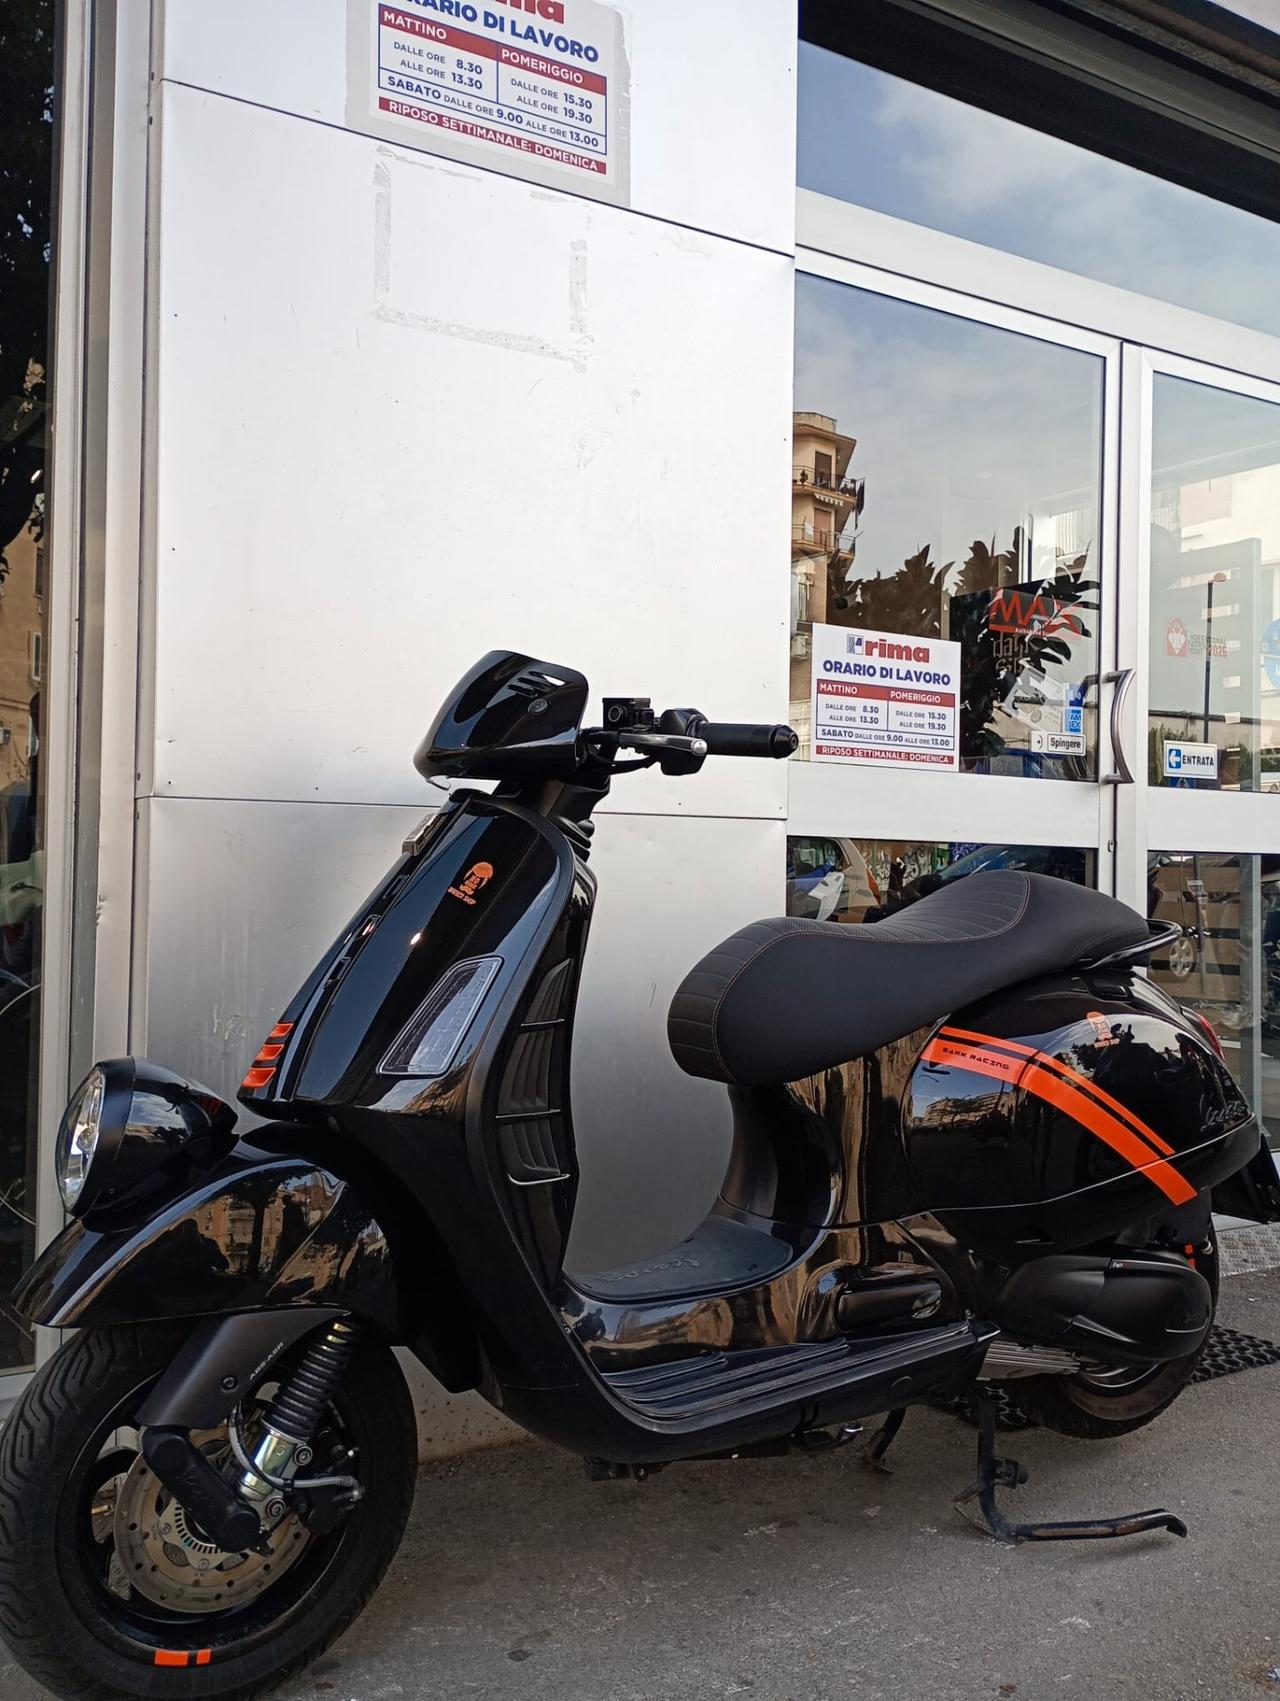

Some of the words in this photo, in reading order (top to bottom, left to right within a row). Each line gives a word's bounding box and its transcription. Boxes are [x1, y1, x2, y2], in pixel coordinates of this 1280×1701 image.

[384, 11, 447, 39] MATTINO
[407, 0, 477, 22] ARIO
[484, 11, 504, 32] DI
[511, 20, 599, 63] LAVORO
[393, 41, 424, 58] DALLE
[426, 51, 446, 64] ORE
[456, 59, 483, 75] 8.30
[501, 48, 583, 83] POMERIGGIO
[400, 59, 424, 73] ALLE
[426, 67, 446, 79] ORE
[452, 73, 483, 90] 13.30
[511, 78, 539, 93] DALLE
[541, 88, 559, 100] ORE
[563, 92, 593, 110] 15.30
[388, 75, 441, 99] SABATO
[443, 94, 473, 110] DALLE
[475, 104, 494, 116] ORE
[496, 109, 523, 125] 9.00
[526, 120, 547, 132] ALLE
[549, 127, 567, 138] ORE
[569, 131, 599, 147] 13.00
[516, 95, 539, 108] ALLE
[541, 102, 559, 114] ORE
[563, 107, 593, 124] 19.30
[389, 101, 438, 124] RIPOSO
[442, 117, 532, 152] SETTIMANALE:
[534, 144, 598, 171] DOMENICA
[823, 660, 877, 677] ORARIO
[880, 667, 893, 679] DI
[896, 669, 951, 686] LAVORO
[820, 683, 858, 695] MATTINO
[890, 690, 941, 703] POMERIGGIO
[825, 703, 844, 711] DALLE
[862, 705, 879, 714] 8.30
[896, 710, 913, 718] DALLE
[928, 711, 947, 720] 15.30
[860, 715, 879, 724] 13.30
[900, 720, 913, 728] ALLE
[928, 722, 947, 731] 19.30
[821, 728, 854, 738] SABATO
[855, 732, 873, 740] DALLE
[886, 734, 904, 742] 9.00
[931, 738, 950, 747] 13.00
[1050, 737, 1081, 749] Spingere
[821, 746, 852, 756] RIPOSO
[853, 748, 908, 760] SETTIMANALE:
[909, 753, 949, 764] DOMENICA
[1182, 755, 1214, 767] ENTRATA
[969, 1054, 1010, 1070] RACING
